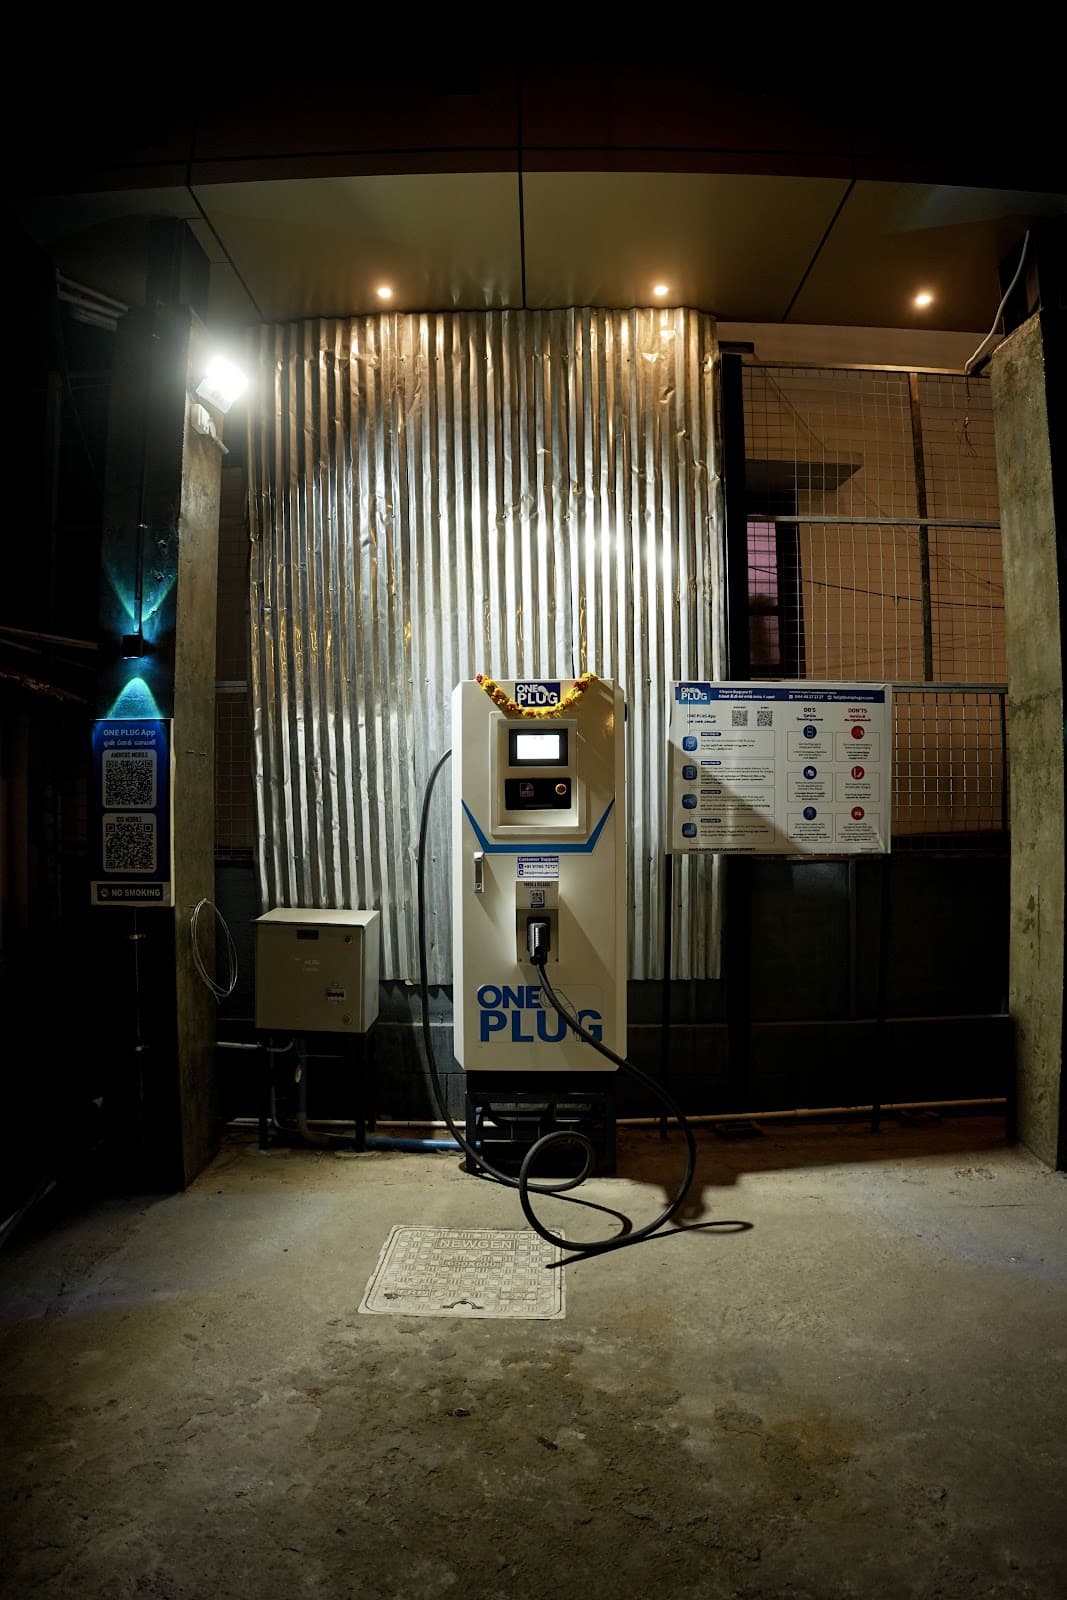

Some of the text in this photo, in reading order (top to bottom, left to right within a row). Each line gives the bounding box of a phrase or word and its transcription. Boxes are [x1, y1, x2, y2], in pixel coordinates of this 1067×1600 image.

[516, 684, 538, 693] ONE
[517, 692, 558, 705] PLUG
[681, 692, 708, 700] PLUG
[141, 729, 156, 738] App
[111, 889, 161, 897] NO SMOKING
[477, 984, 543, 1009] ONE
[480, 1009, 603, 1043] PLUG
[438, 1239, 512, 1249] NEWGEN
